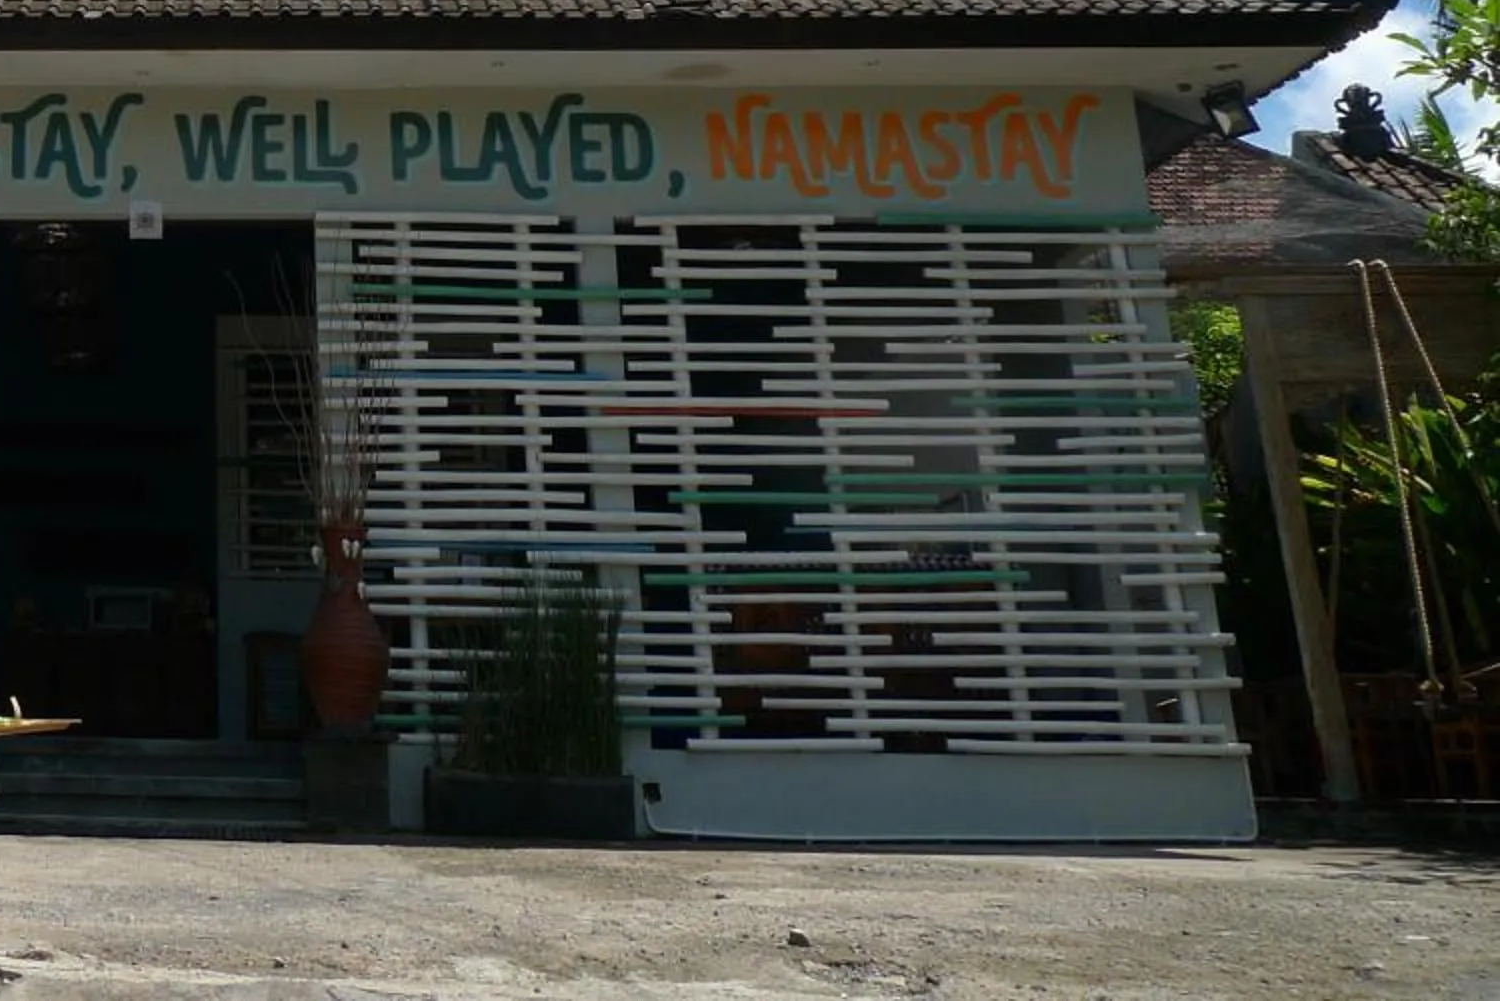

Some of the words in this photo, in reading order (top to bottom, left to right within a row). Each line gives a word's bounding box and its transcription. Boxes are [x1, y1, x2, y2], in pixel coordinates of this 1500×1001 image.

[174, 95, 358, 195] WELL
[389, 92, 685, 201] PLAYED,
[705, 91, 1098, 197] NAMASTAY
